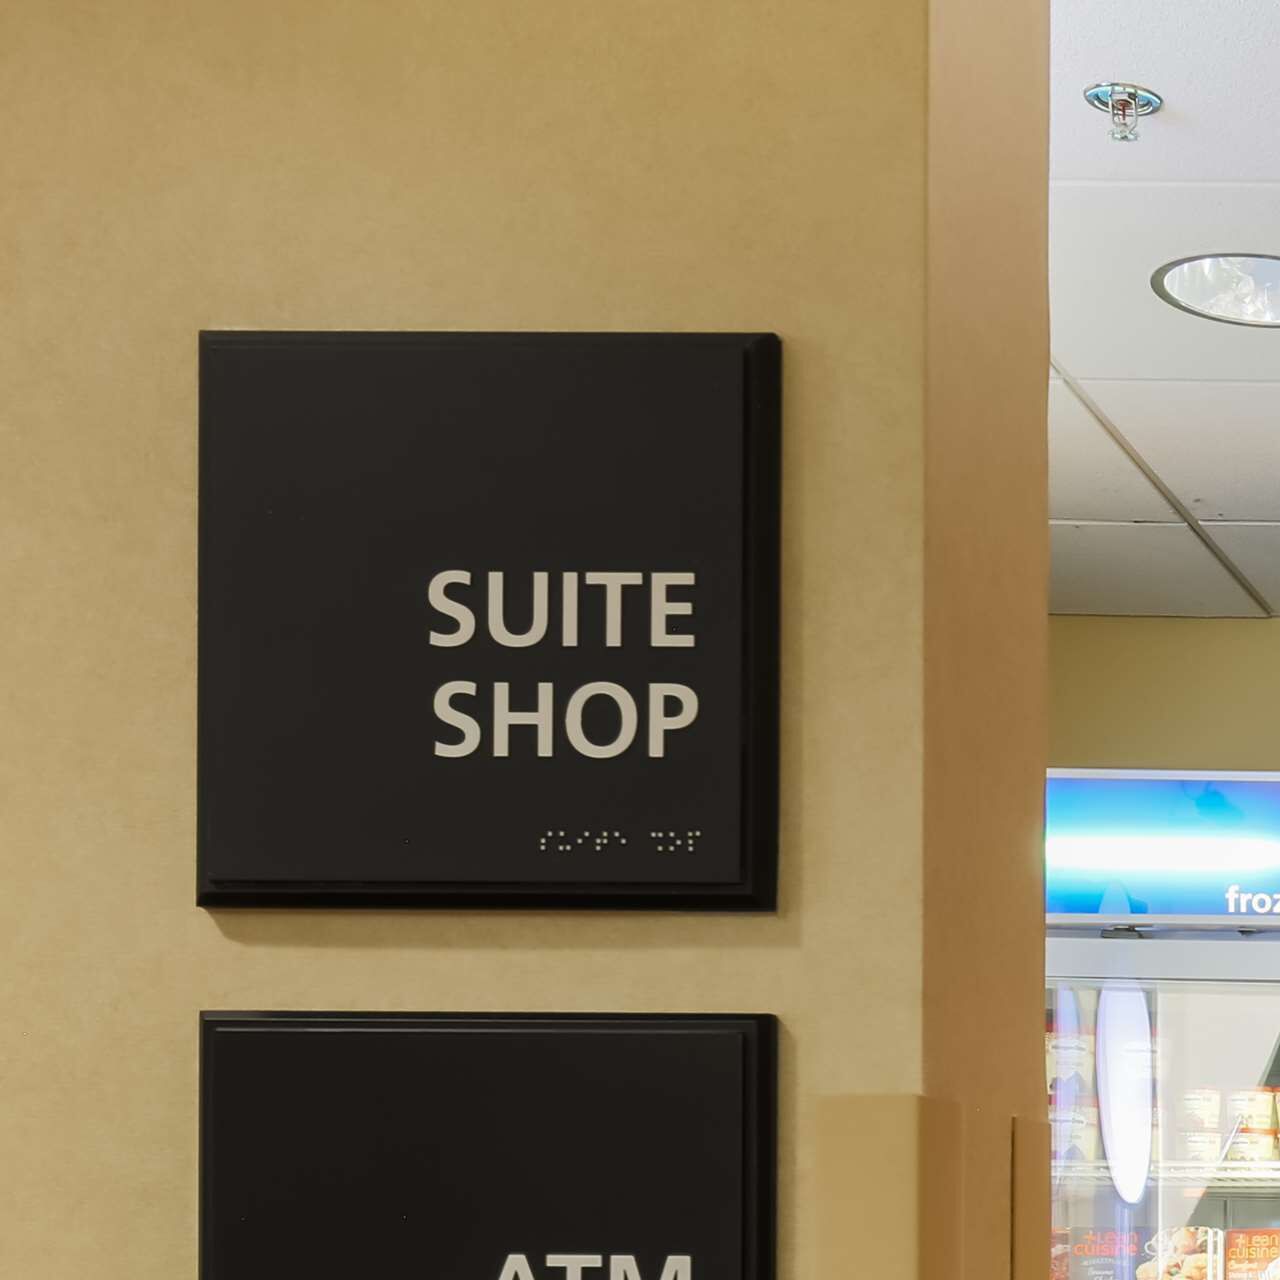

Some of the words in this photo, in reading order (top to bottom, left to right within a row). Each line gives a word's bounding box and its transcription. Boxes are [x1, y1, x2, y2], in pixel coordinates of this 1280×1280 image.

[427, 569, 696, 648] SUITE
[432, 680, 699, 759] SHOP
[1229, 1246, 1279, 1259] cuisine
